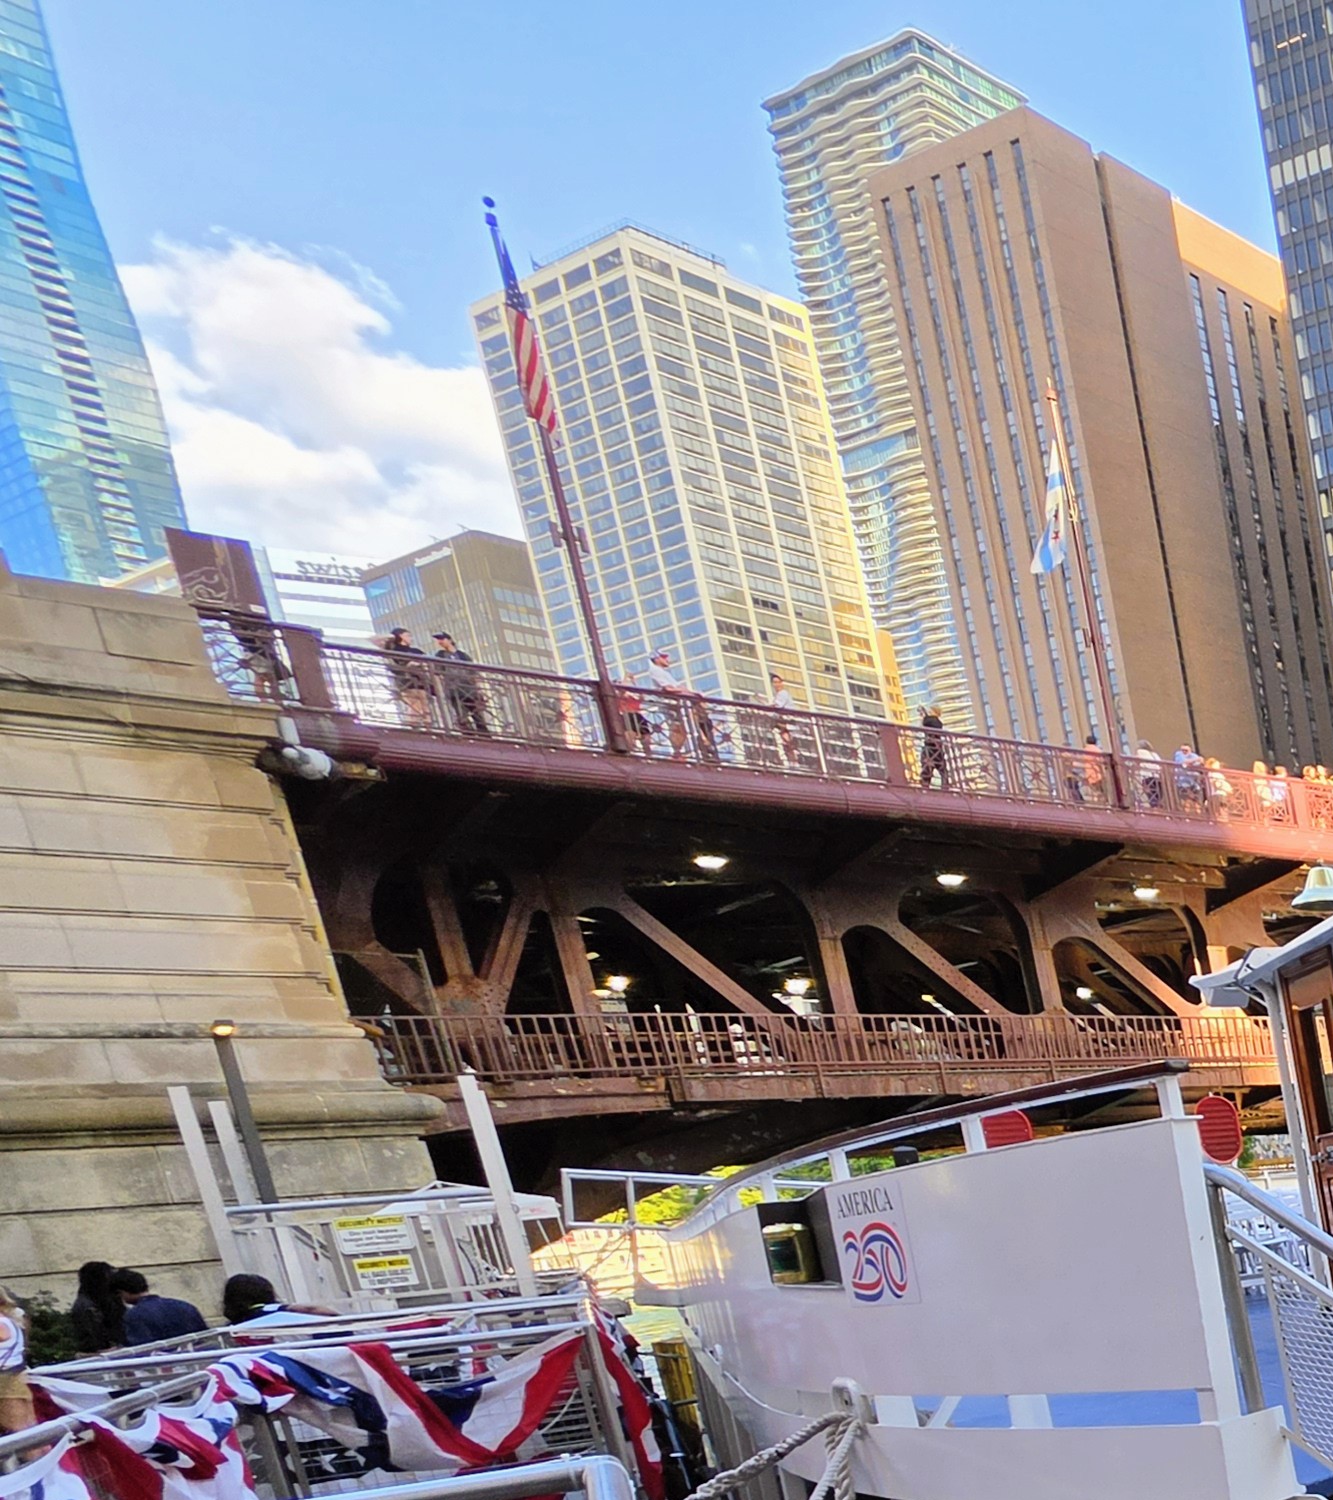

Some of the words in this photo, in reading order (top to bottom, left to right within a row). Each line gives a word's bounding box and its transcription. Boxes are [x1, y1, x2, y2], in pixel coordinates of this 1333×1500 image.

[838, 1186, 894, 1220] AMERICA
[338, 1218, 375, 1228] SECURITY
[376, 1216, 404, 1224] NOTICE
[843, 1221, 908, 1303] 250
